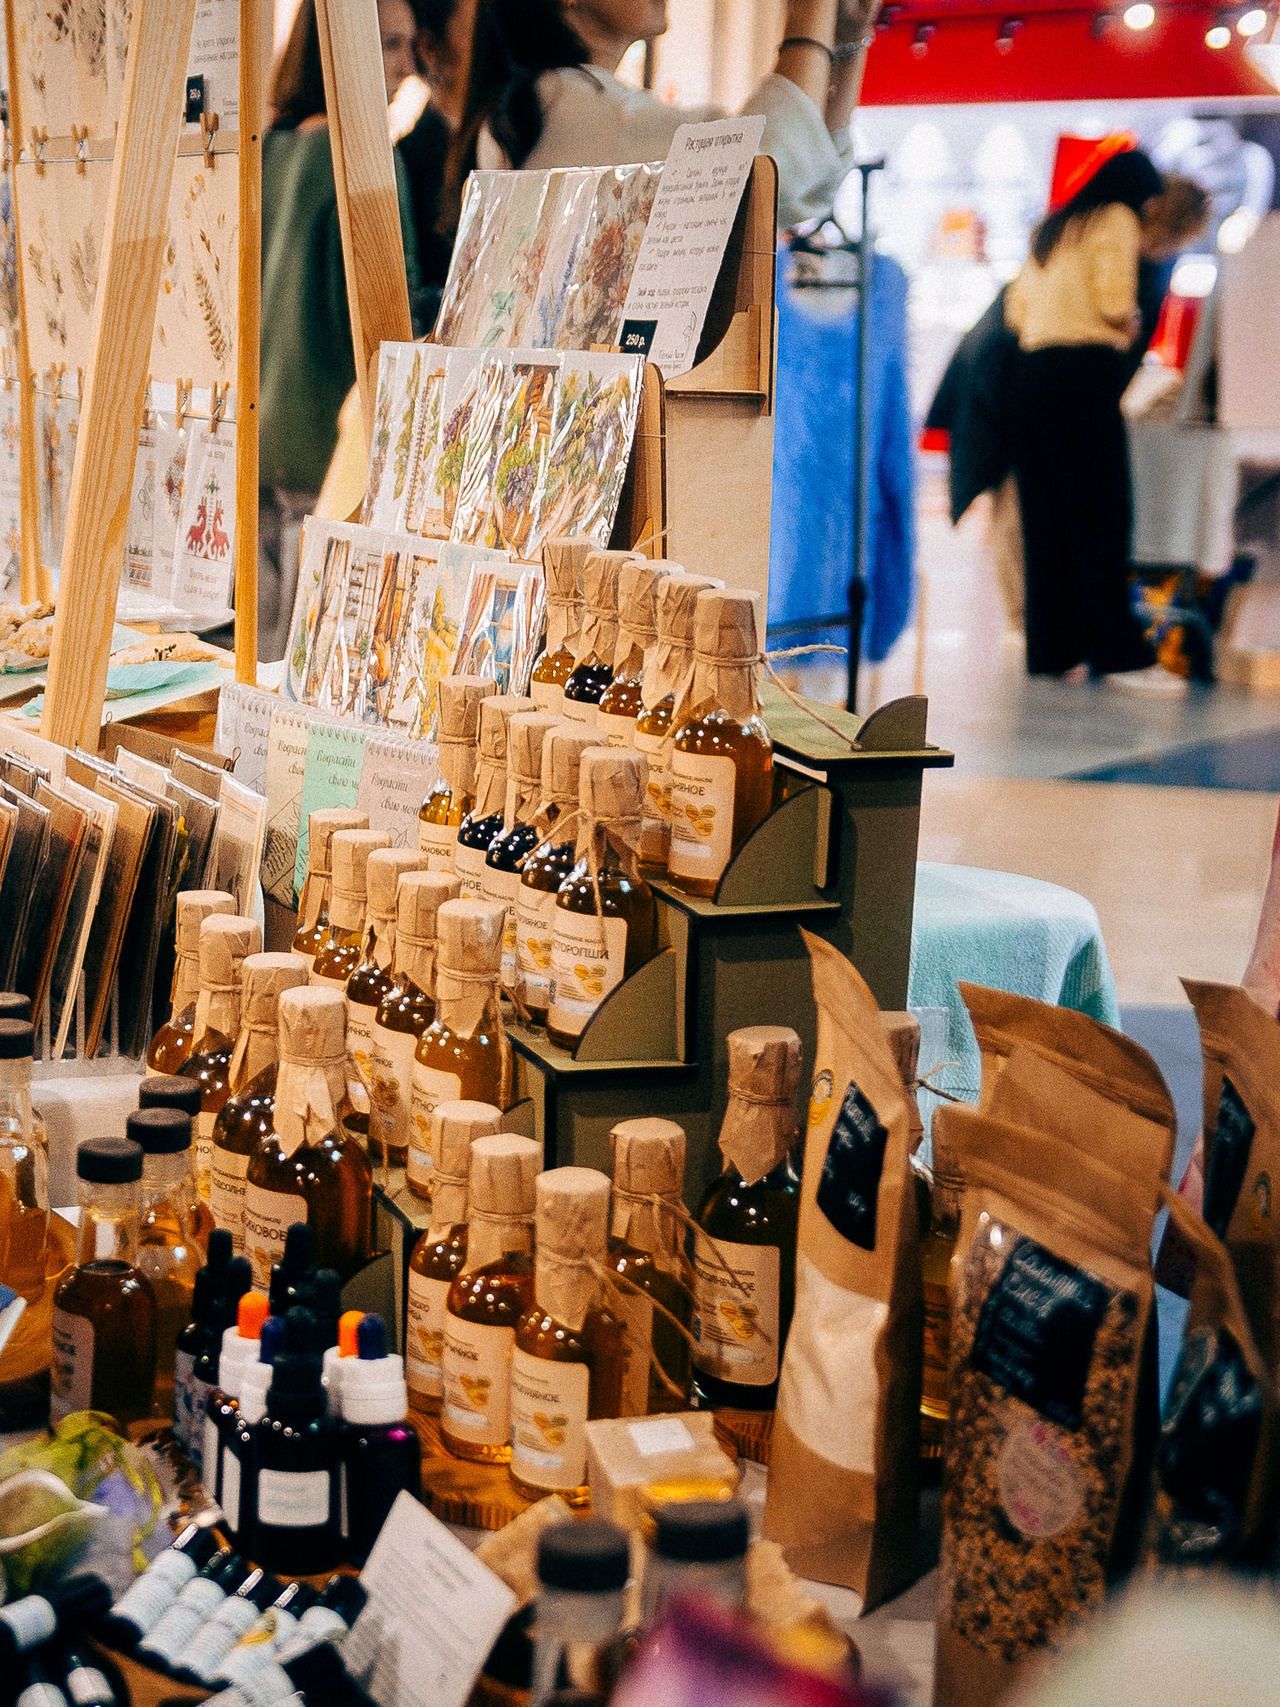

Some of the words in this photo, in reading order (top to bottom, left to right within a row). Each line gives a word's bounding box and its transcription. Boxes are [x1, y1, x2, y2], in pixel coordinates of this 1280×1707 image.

[625, 333, 639, 346] 250
[316, 749, 356, 769] Вырасти
[370, 772, 409, 793] Вырасти
